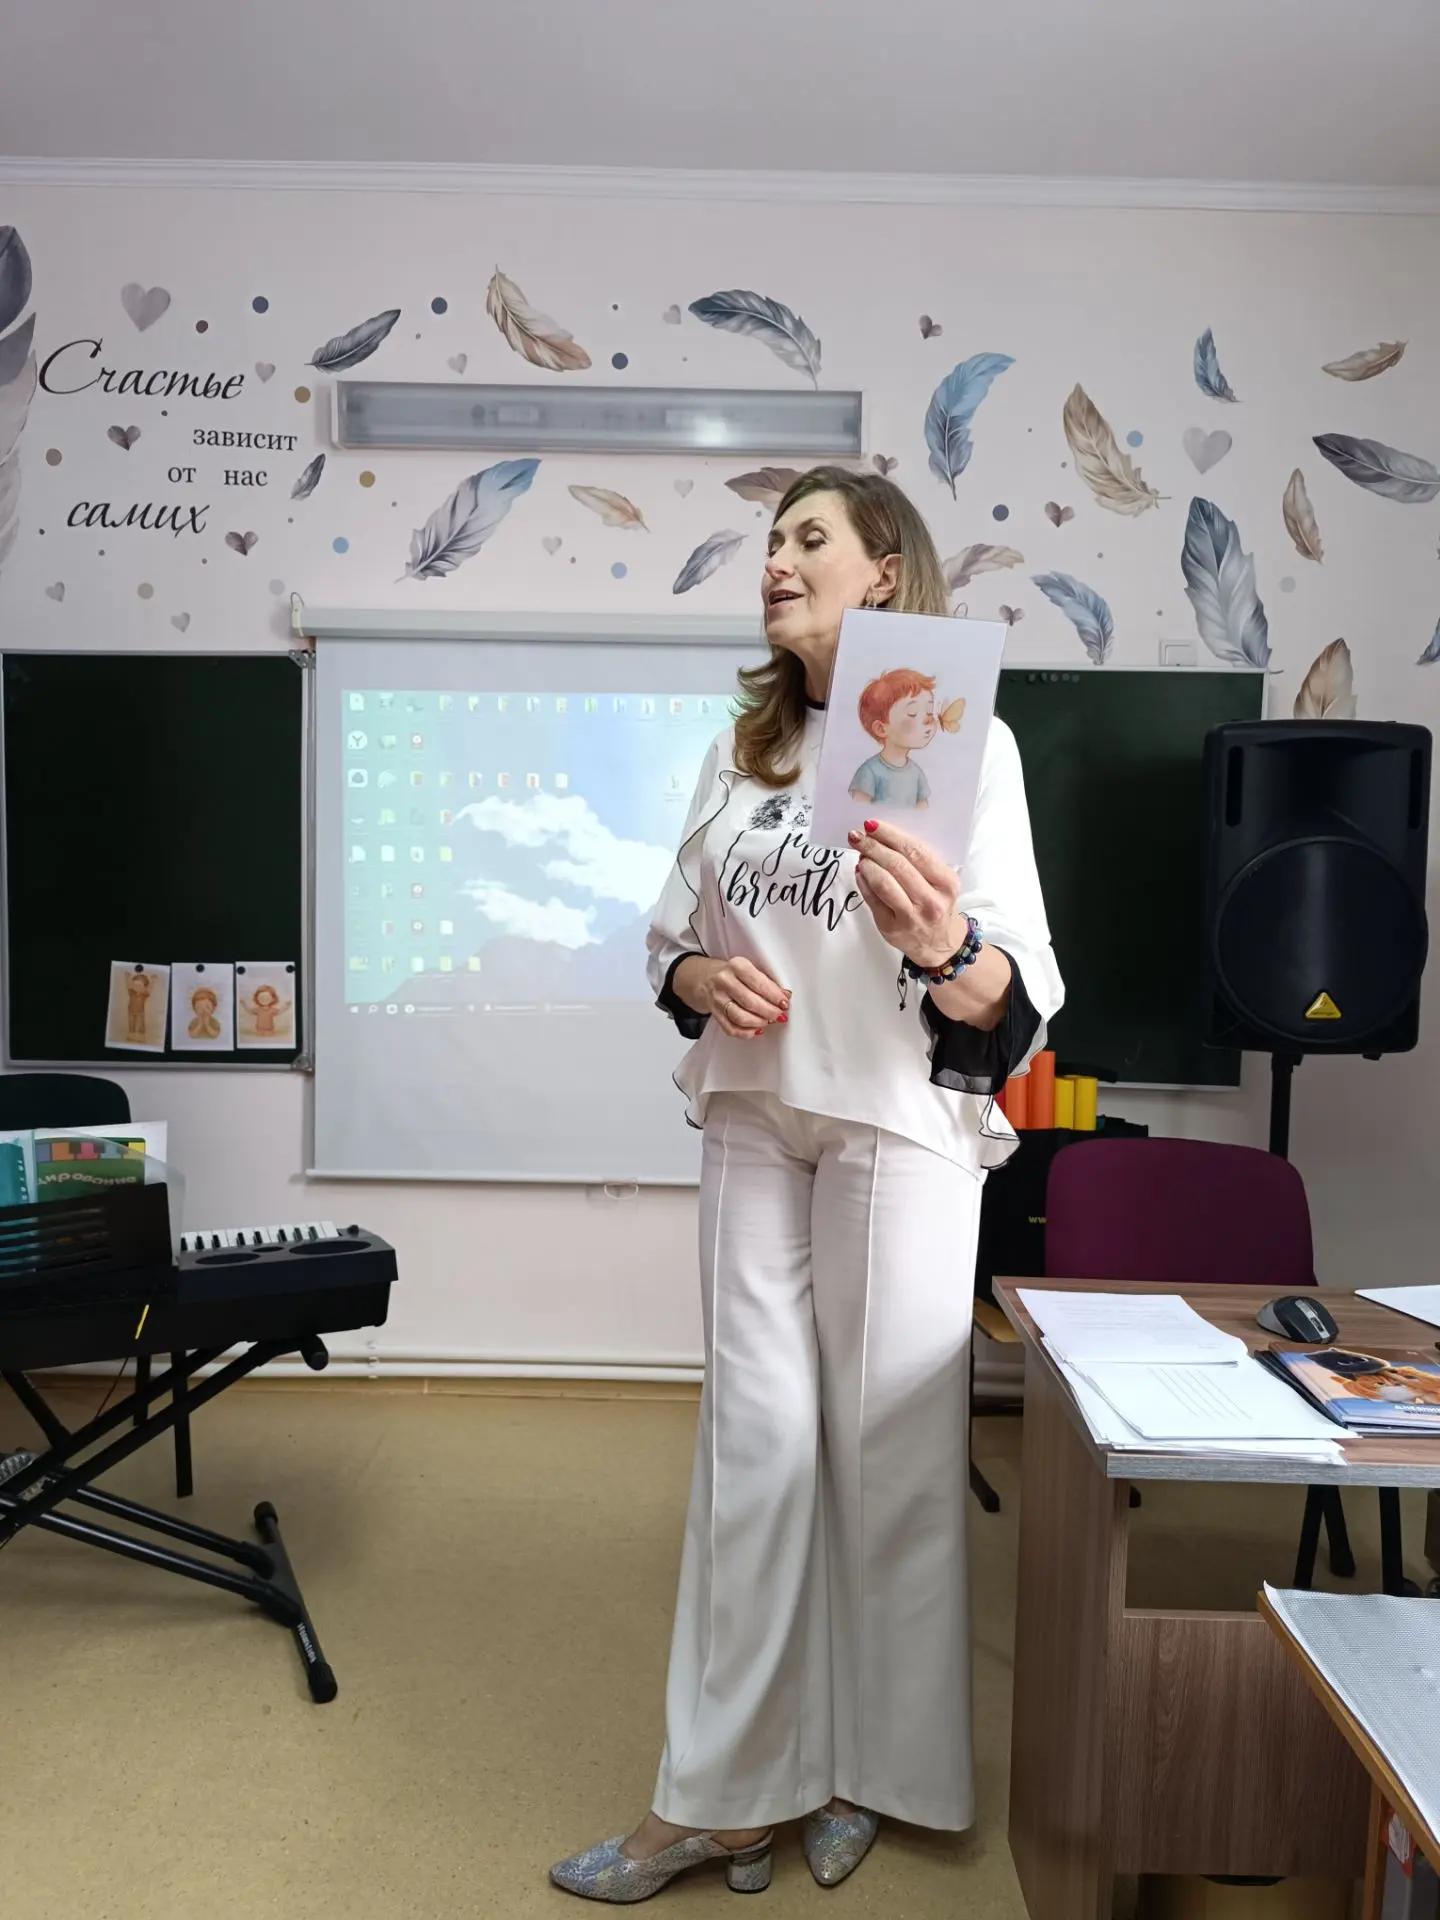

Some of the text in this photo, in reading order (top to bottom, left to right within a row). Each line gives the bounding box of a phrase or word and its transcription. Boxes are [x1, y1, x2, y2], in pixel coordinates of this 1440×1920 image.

[38, 338, 244, 400] Счастье
[193, 429, 297, 451] зависит
[167, 466, 268, 487] от нас
[67, 501, 210, 538] самих
[726, 859, 865, 932] breathe
